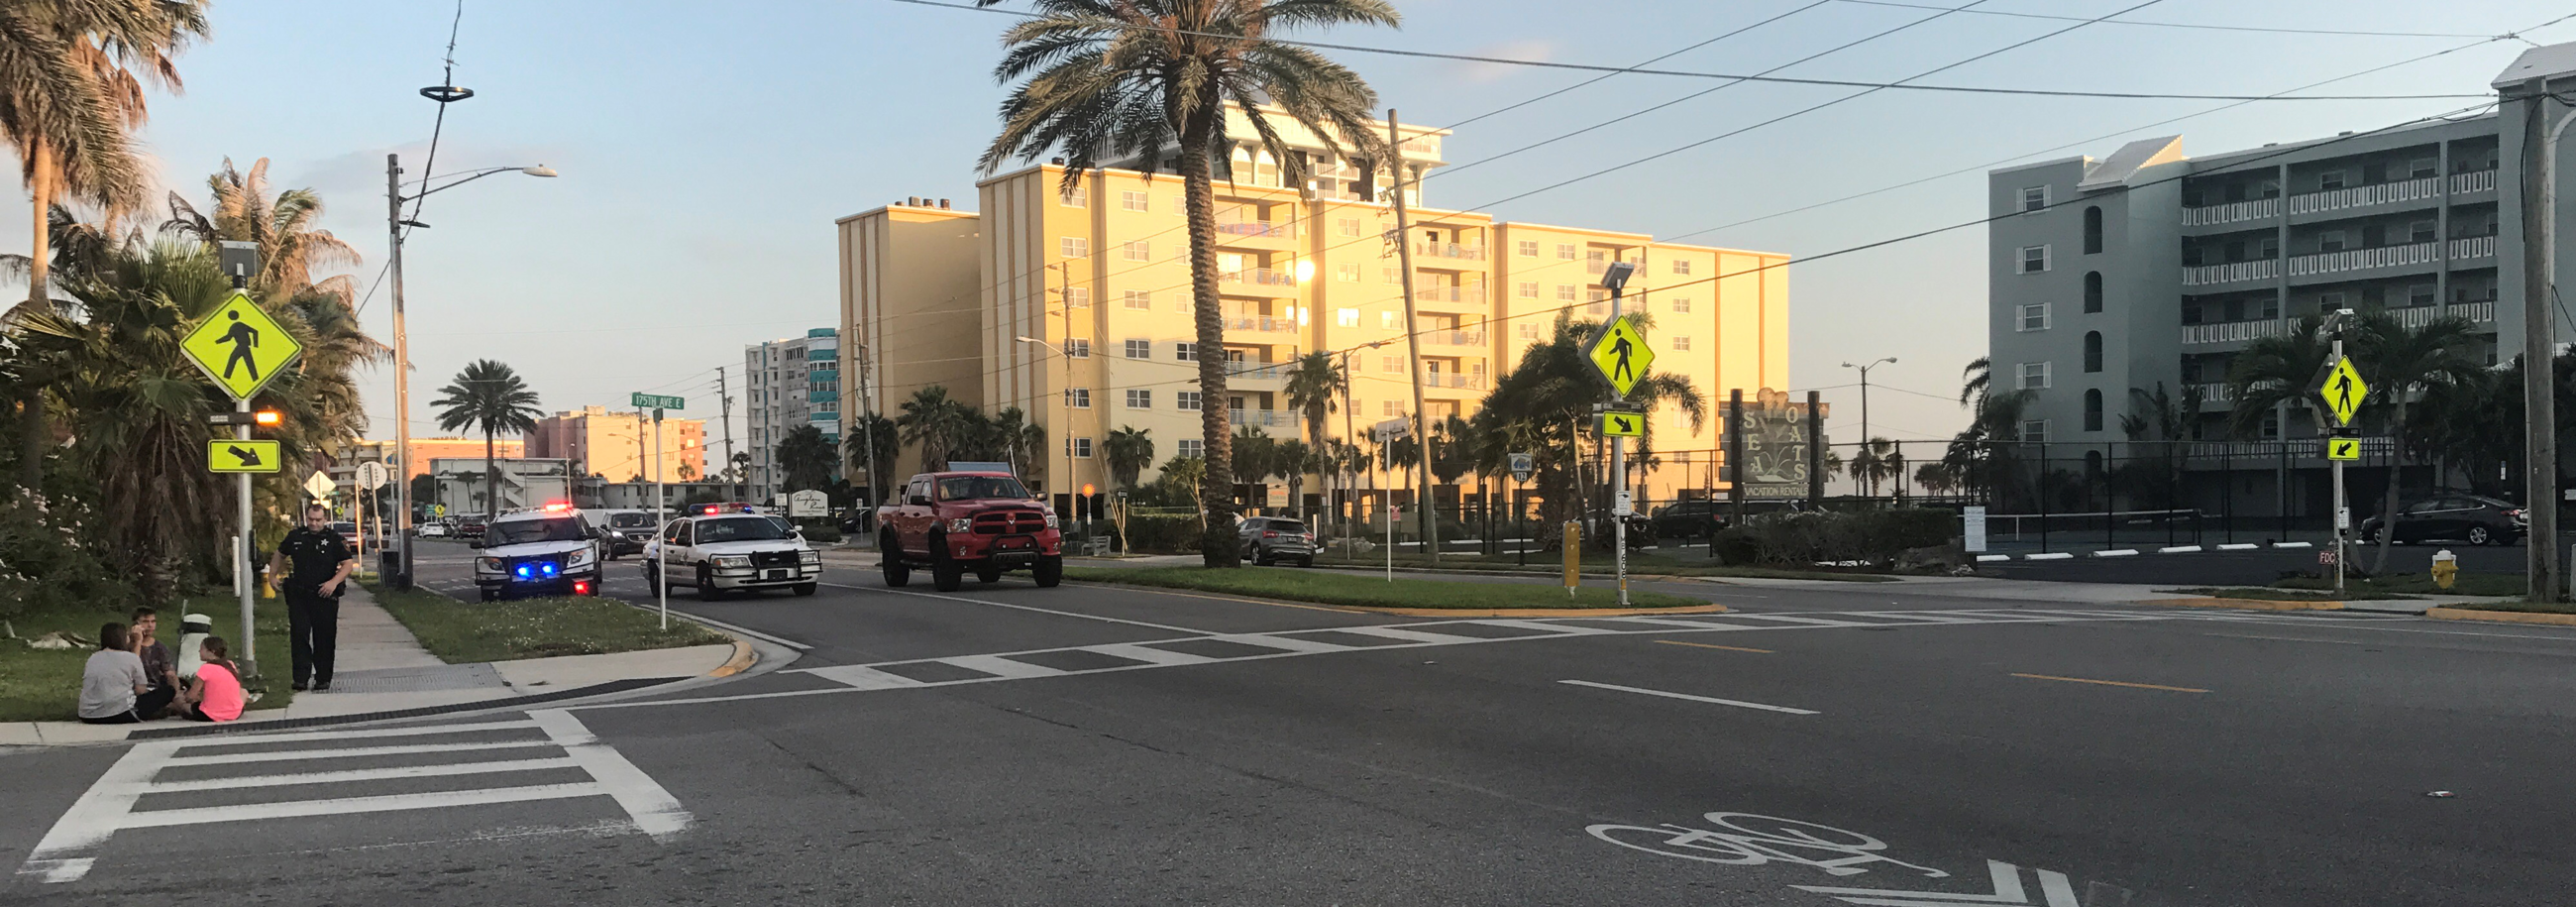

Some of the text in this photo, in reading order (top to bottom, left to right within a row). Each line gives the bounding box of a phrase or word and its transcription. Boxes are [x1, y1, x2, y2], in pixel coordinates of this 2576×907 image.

[636, 396, 681, 407] 175TH AVE E
[1744, 411, 1764, 473] SEA
[1785, 406, 1806, 481] OATS
[1744, 487, 1809, 496] VACATION RENTALS
[2319, 552, 2335, 563] FDC
